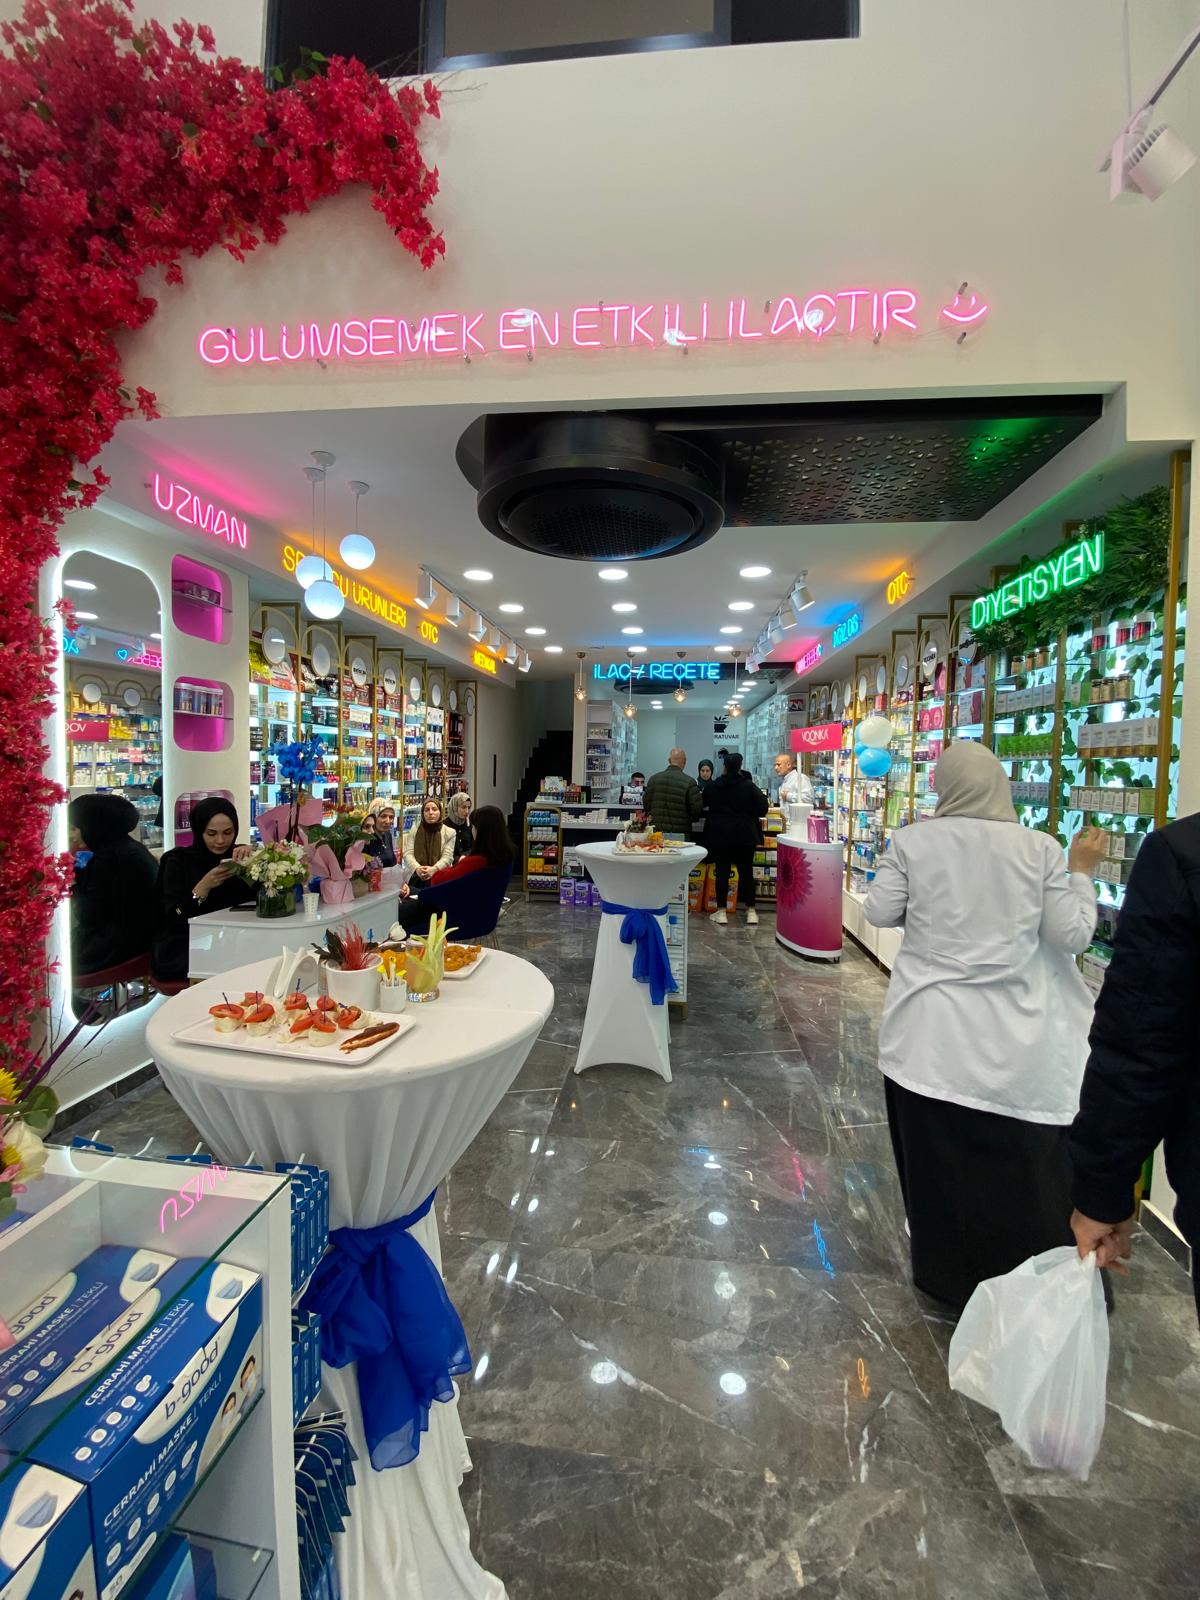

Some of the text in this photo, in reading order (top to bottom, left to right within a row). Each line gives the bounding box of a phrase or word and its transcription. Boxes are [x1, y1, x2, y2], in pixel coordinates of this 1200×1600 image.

[499, 310, 560, 350] EN
[154, 473, 248, 549] UZMAN
[887, 571, 910, 605] OTC
[420, 621, 439, 644] OTC
[649, 663, 720, 681] REÇETE
[36, 1307, 75, 1339] MASKE
[71, 1311, 144, 1374] b-good
[127, 1326, 164, 1361] MASKE
[165, 1340, 220, 1420] b-good
[103, 1460, 157, 1528] CERRAHİ
[157, 1416, 193, 1466] MASKE
